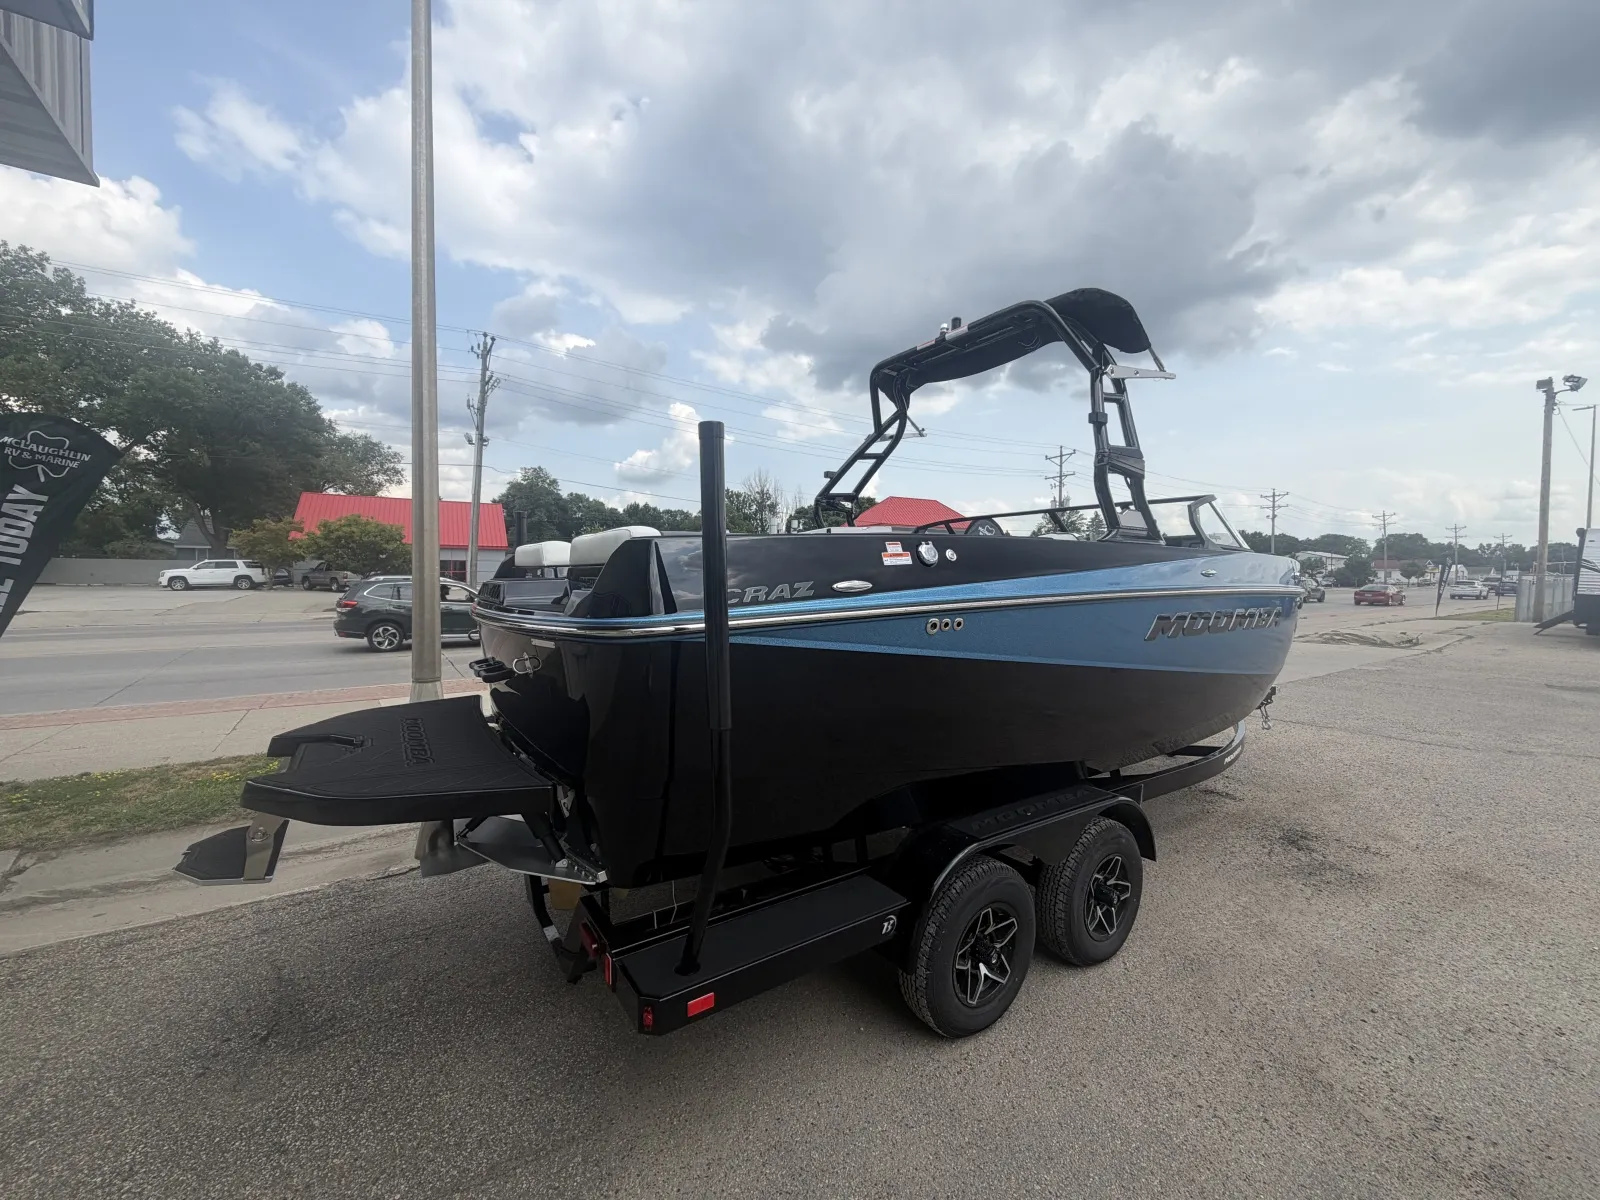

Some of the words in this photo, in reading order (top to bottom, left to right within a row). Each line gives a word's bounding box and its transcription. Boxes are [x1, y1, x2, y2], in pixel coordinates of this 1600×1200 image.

[0, 436, 91, 461] MCLAUGHLIN
[4, 447, 20, 456] RV
[35, 454, 80, 468] MARINE
[728, 581, 814, 604] CRAZ
[1144, 607, 1282, 641] MOOMBA
[403, 718, 435, 766] MOOMBA
